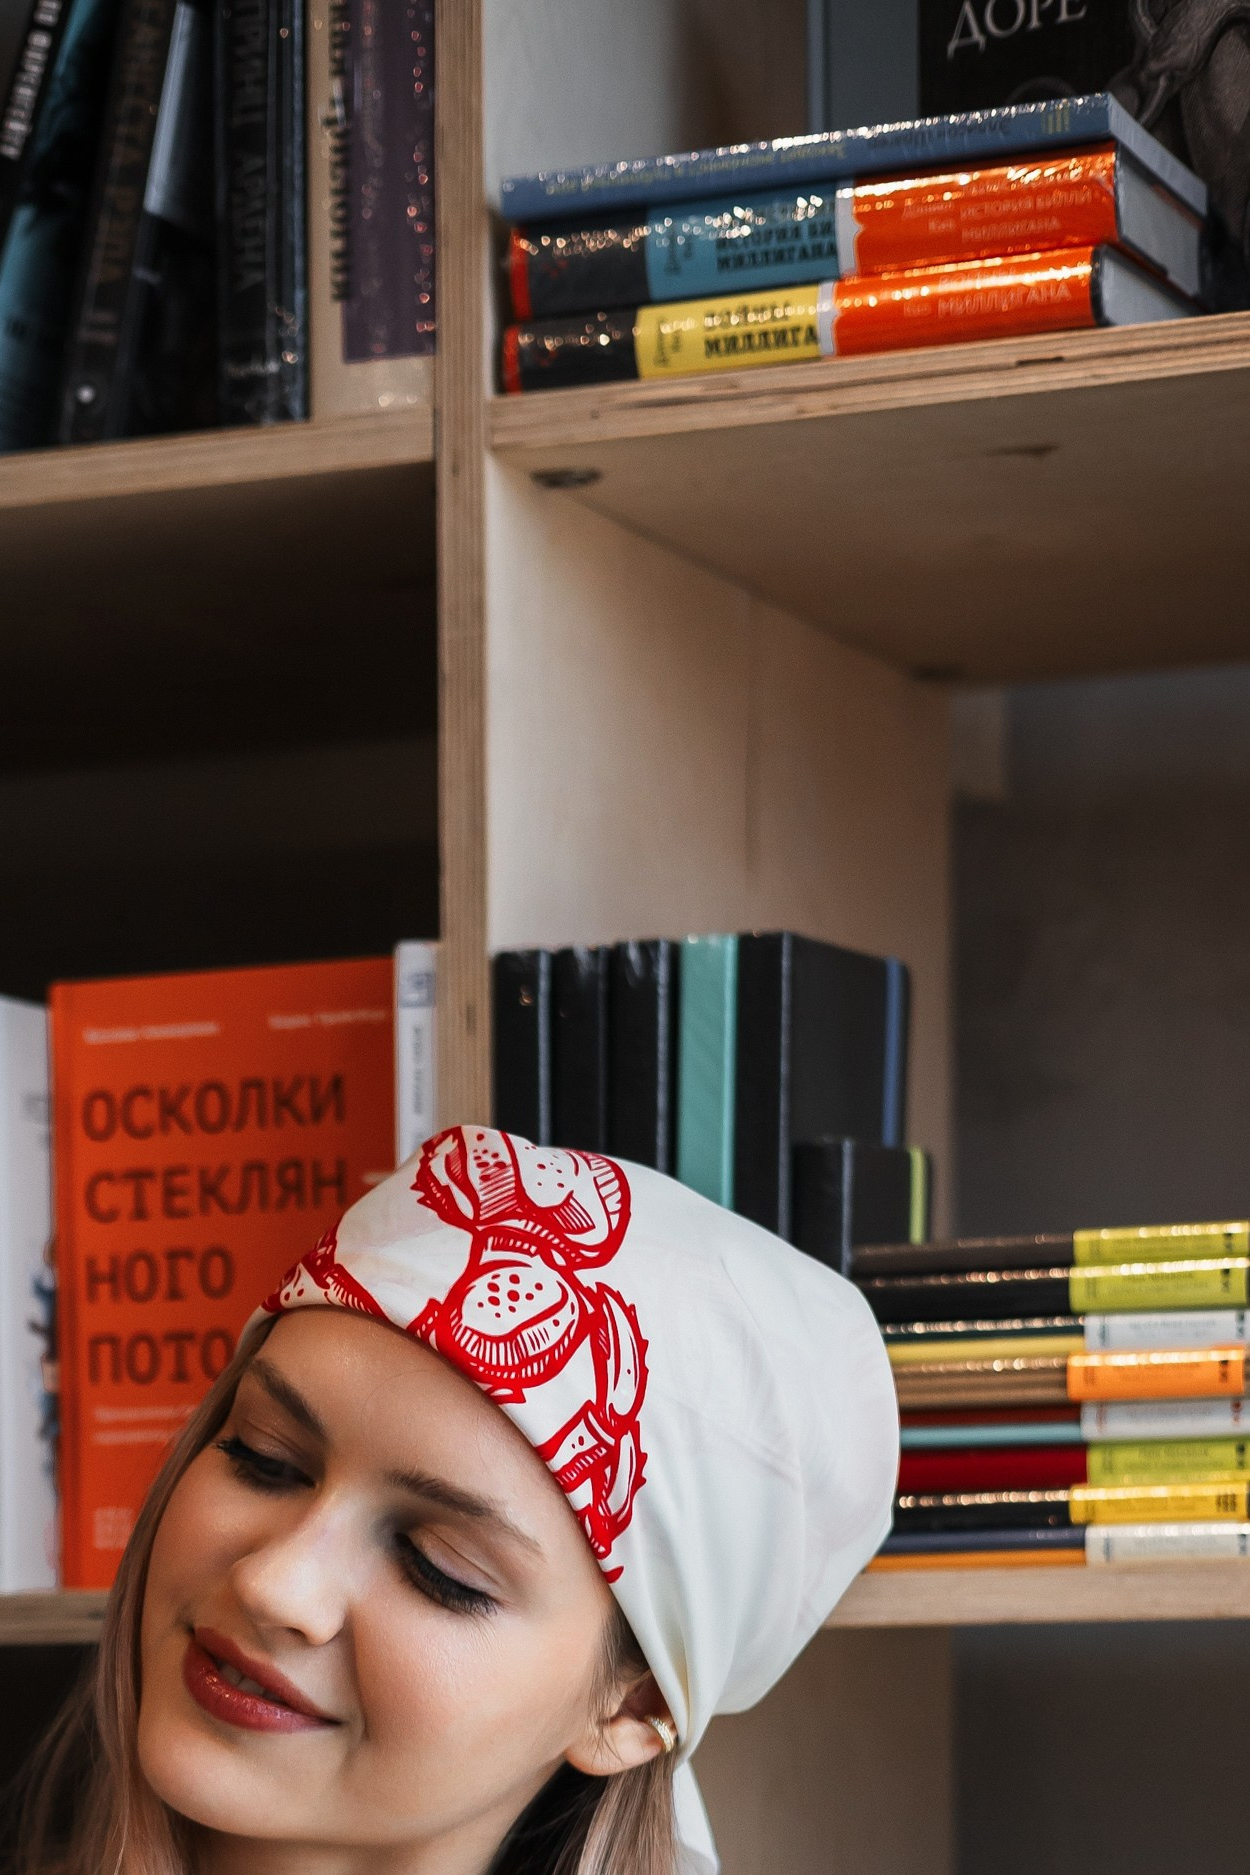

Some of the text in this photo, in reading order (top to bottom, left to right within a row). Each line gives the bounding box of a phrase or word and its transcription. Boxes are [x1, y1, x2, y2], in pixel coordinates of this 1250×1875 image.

[81, 1073, 347, 1142] ОСКОЛКИ
[84, 1157, 347, 1224] СТЕКЛЯН
[86, 1244, 236, 1305] НОГО
[87, 1328, 236, 1387] ПОТО
